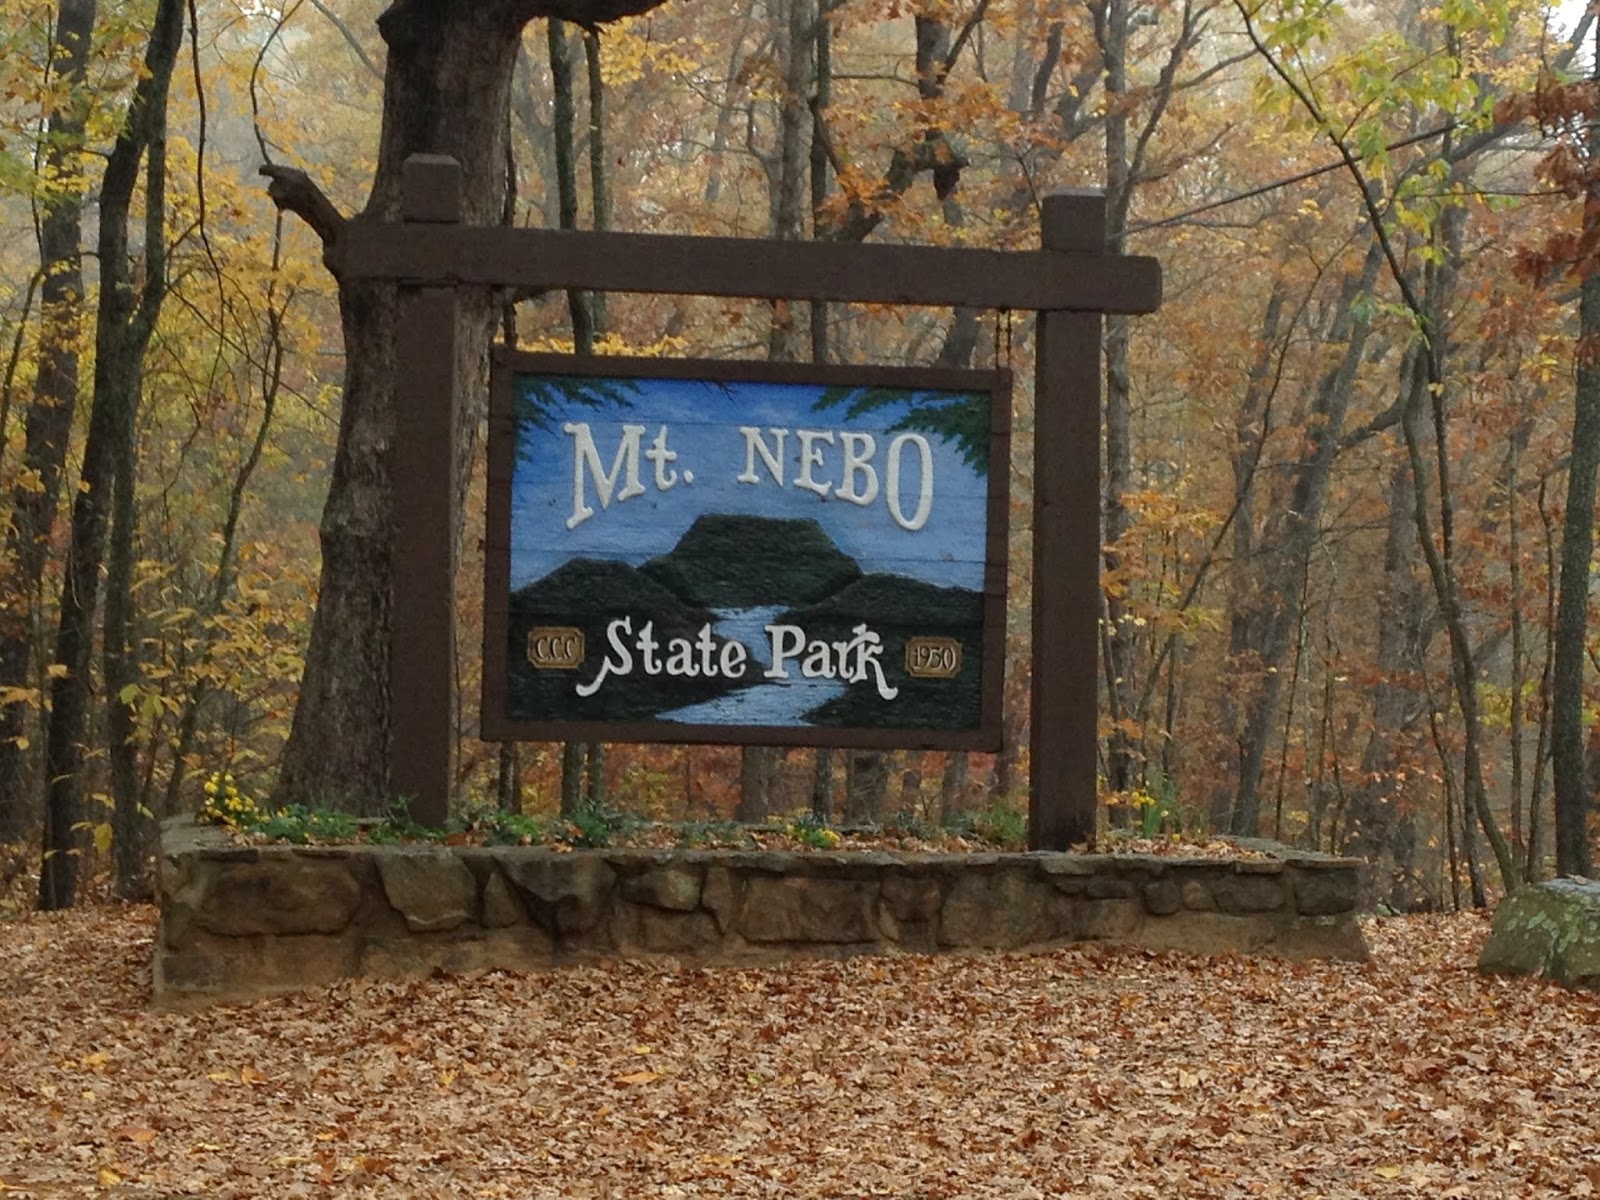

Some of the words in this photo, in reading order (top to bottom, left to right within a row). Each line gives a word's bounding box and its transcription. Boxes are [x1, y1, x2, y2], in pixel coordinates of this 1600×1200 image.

[563, 422, 694, 530] Mt.
[737, 426, 934, 531] NEBO
[576, 615, 747, 697] State
[763, 622, 898, 700] Park
